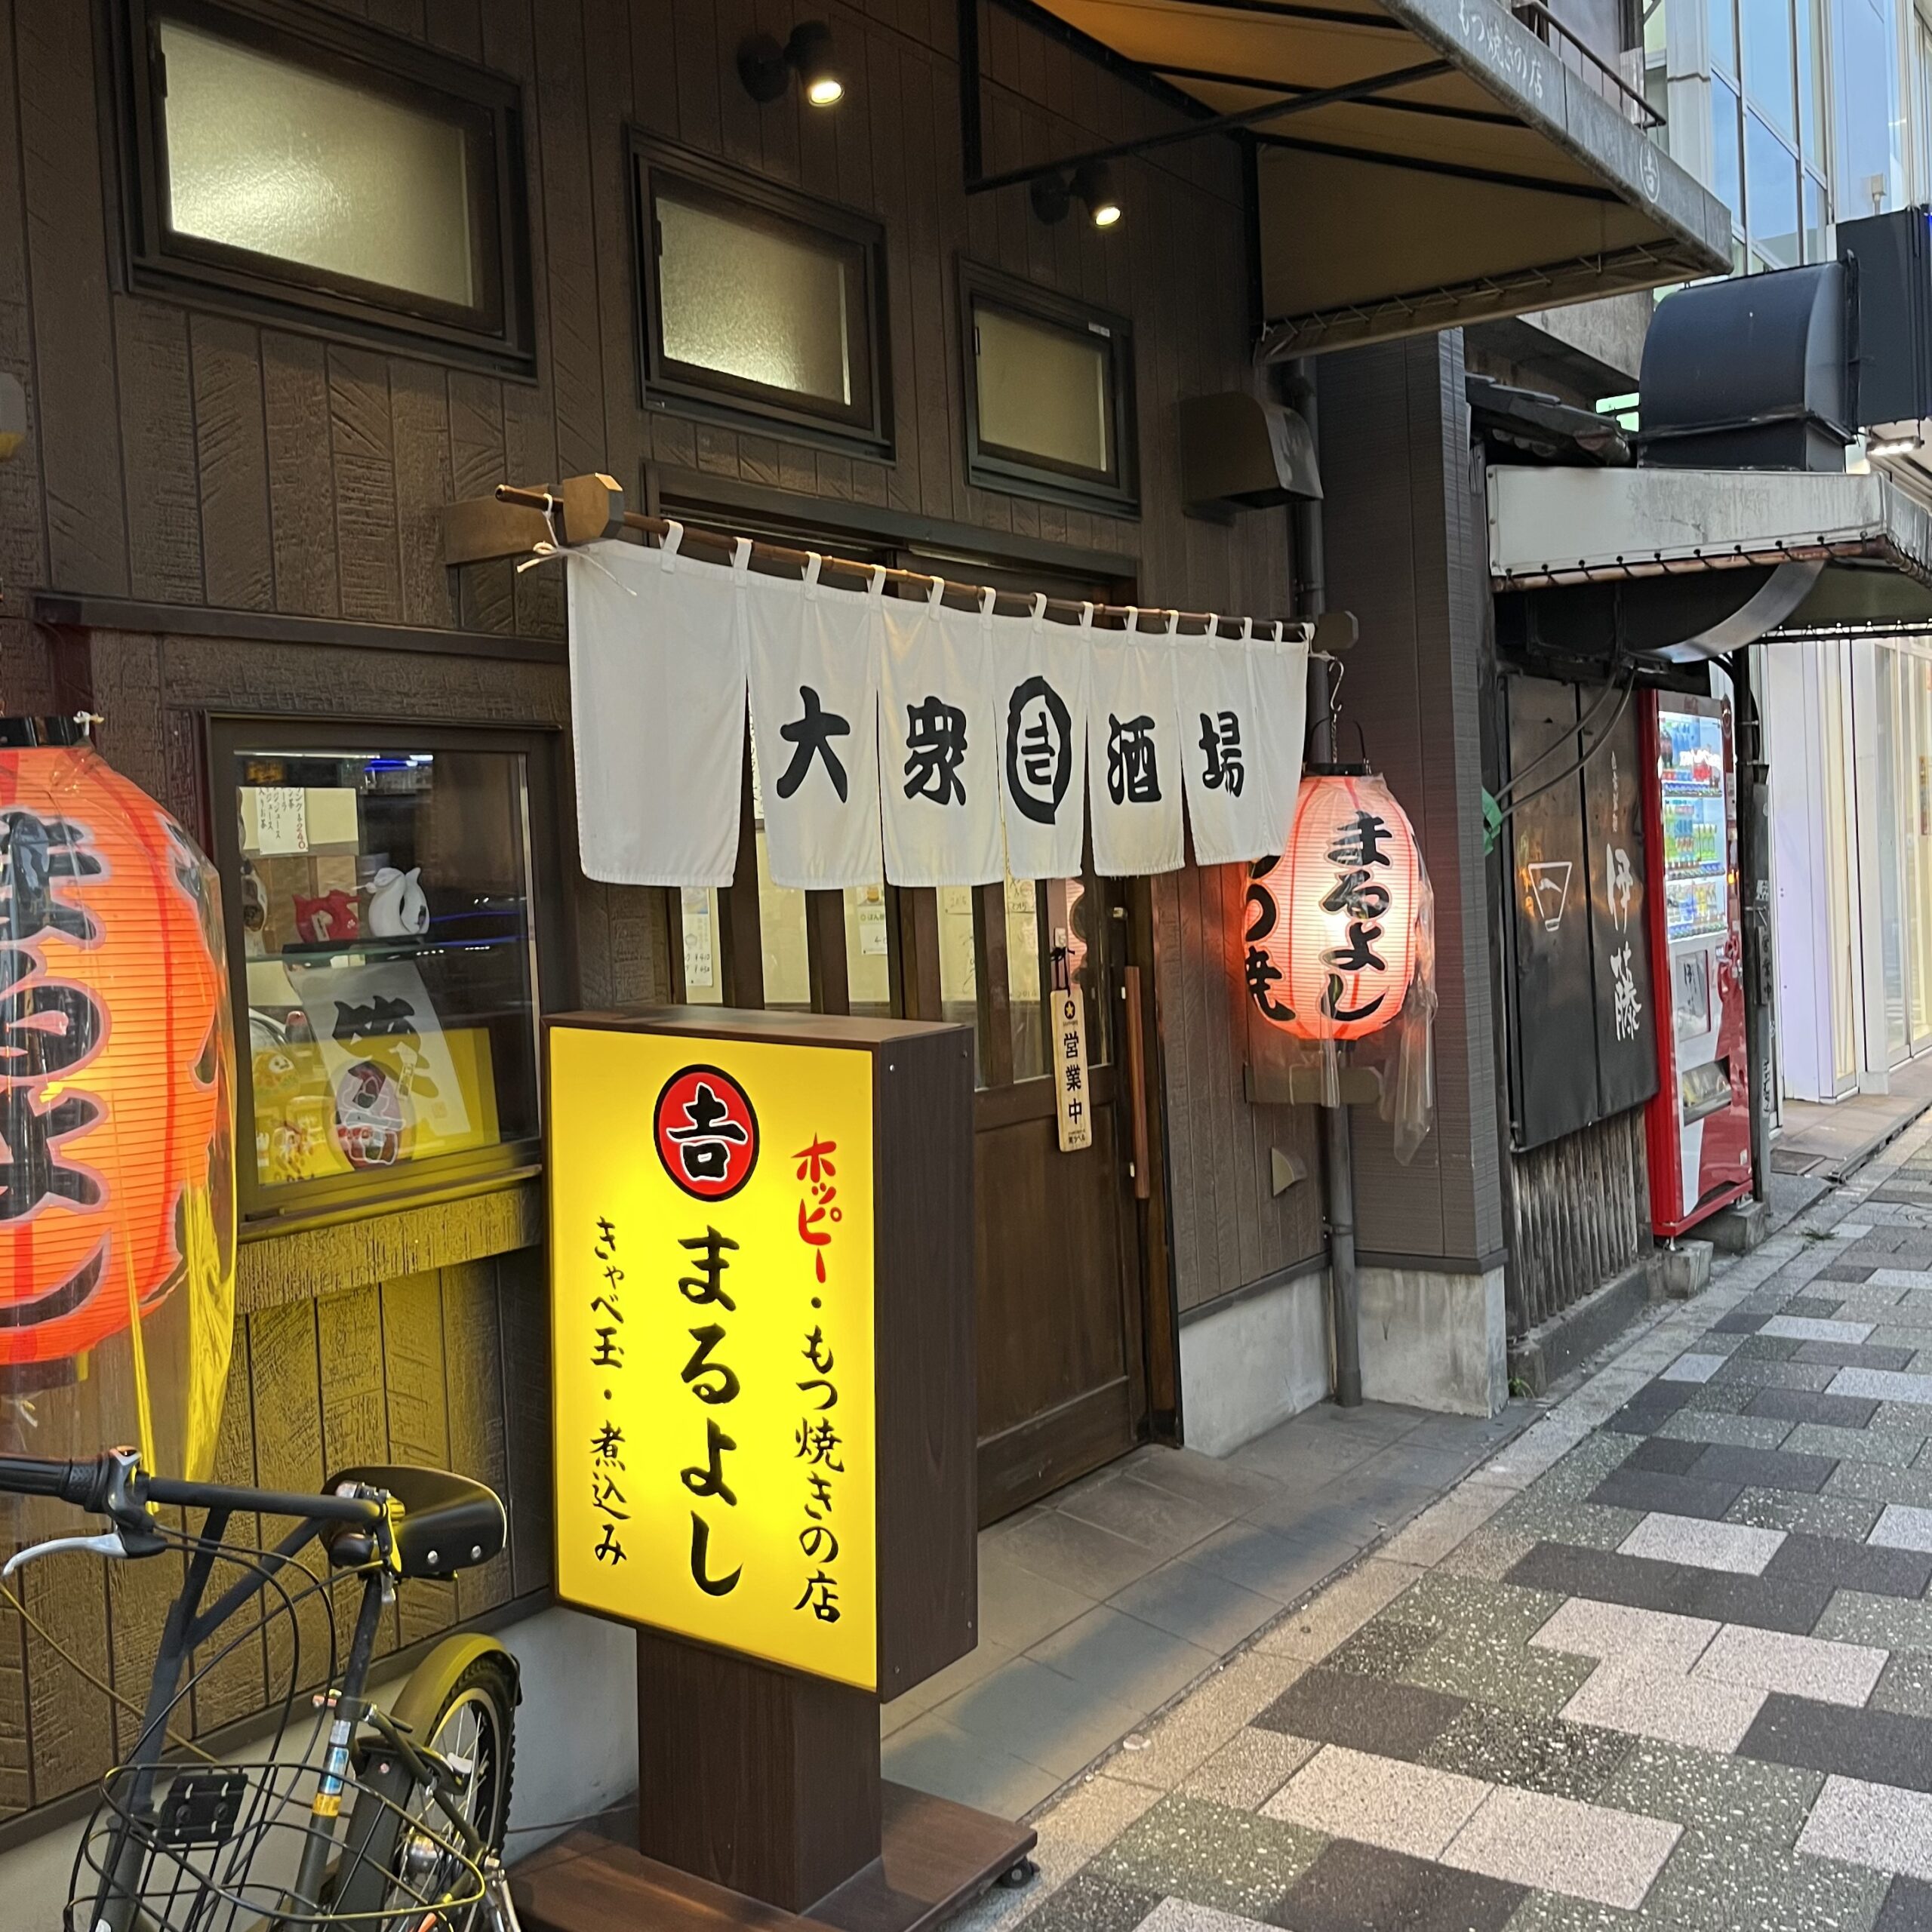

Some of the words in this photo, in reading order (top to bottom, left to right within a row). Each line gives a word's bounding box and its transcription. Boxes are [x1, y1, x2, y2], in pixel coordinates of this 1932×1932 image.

[1064, 1031, 1082, 1124] 営業中
[1321, 811, 1395, 1022] まるよし
[590, 1217, 629, 1567] きゃべ玉・煮込み
[678, 1224, 743, 1598] まるよし
[791, 1132, 844, 1623] ホッピー・もつ焼きの店
